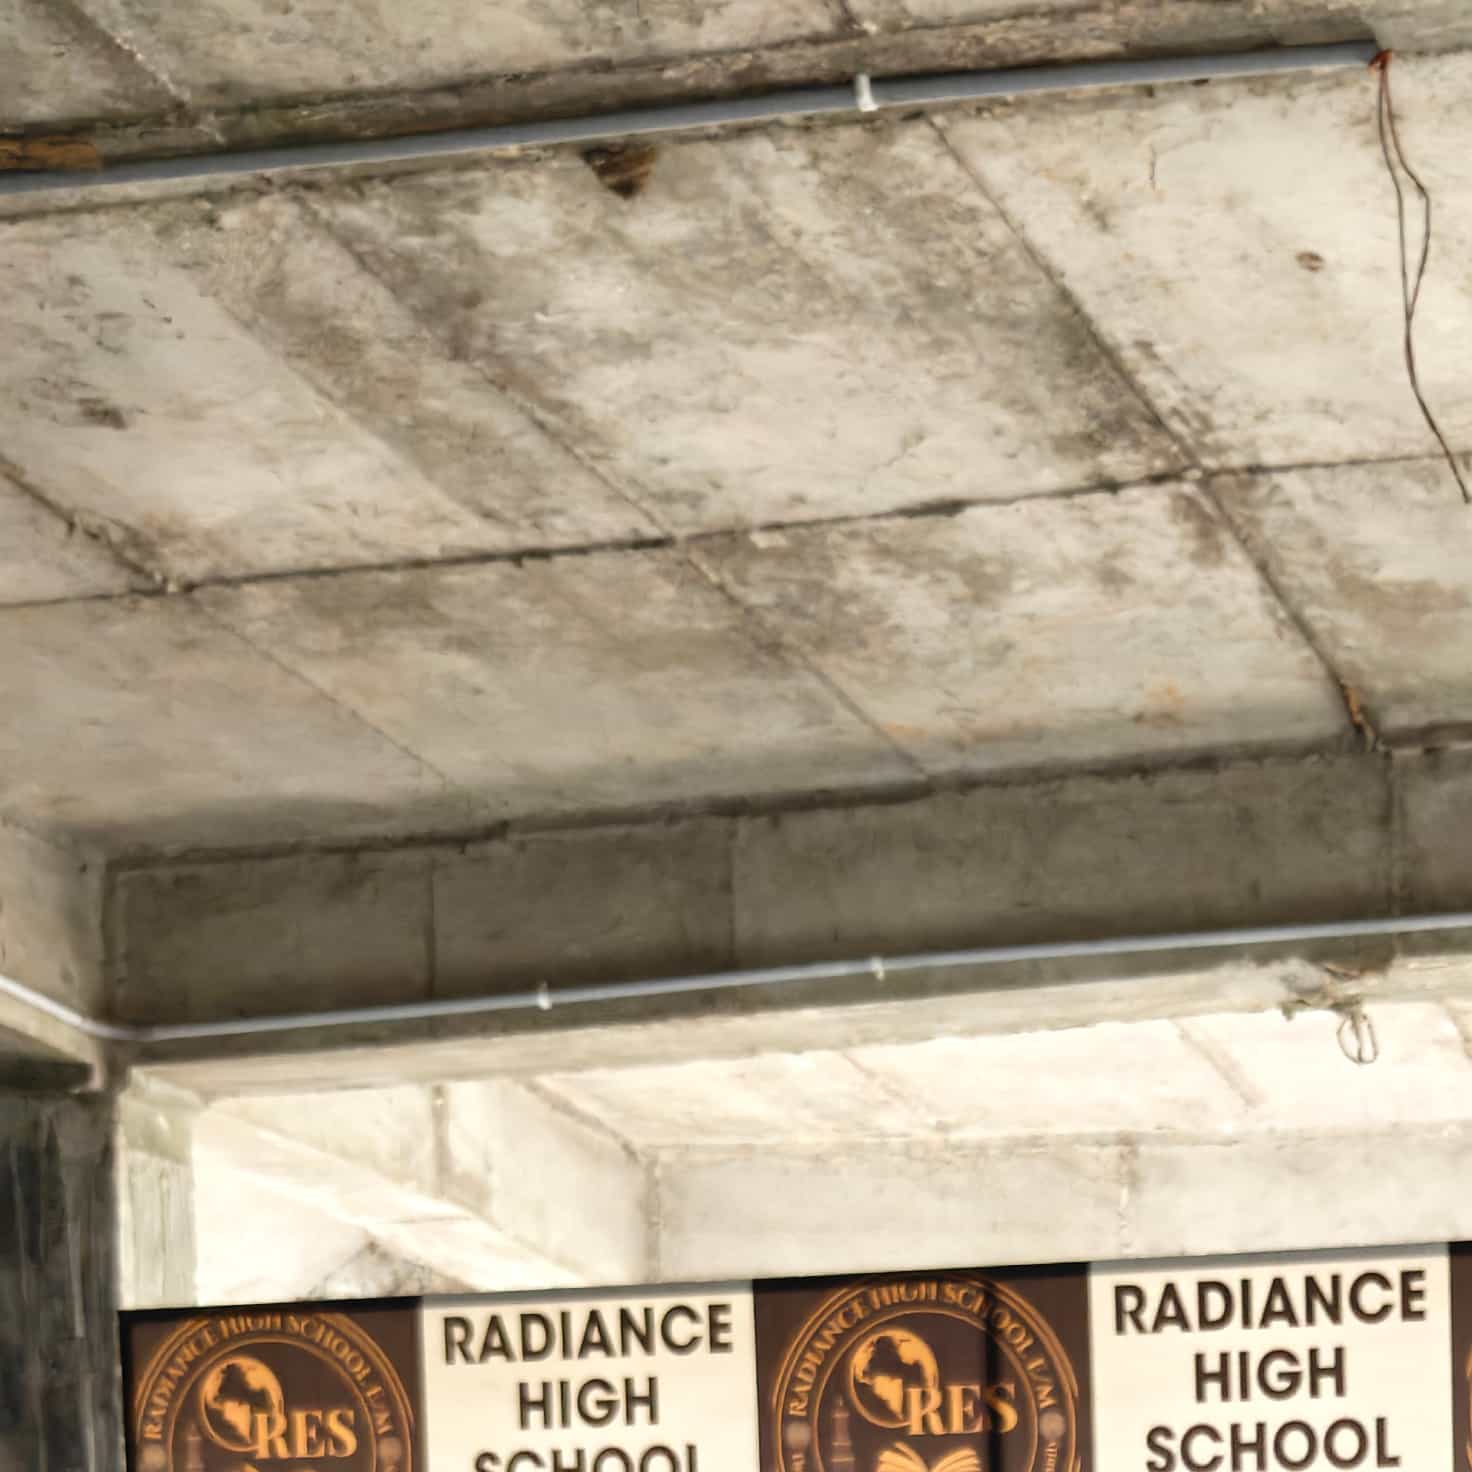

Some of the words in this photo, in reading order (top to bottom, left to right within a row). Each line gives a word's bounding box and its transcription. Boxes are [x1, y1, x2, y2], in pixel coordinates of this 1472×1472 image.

[1114, 1270, 1425, 1334] RADIANCE
[444, 1304, 731, 1364] RADIANCE
[1195, 1347, 1344, 1402] HIGH
[519, 1377, 657, 1429] HIGH
[904, 1382, 1017, 1436] RES
[252, 1409, 356, 1459] RES
